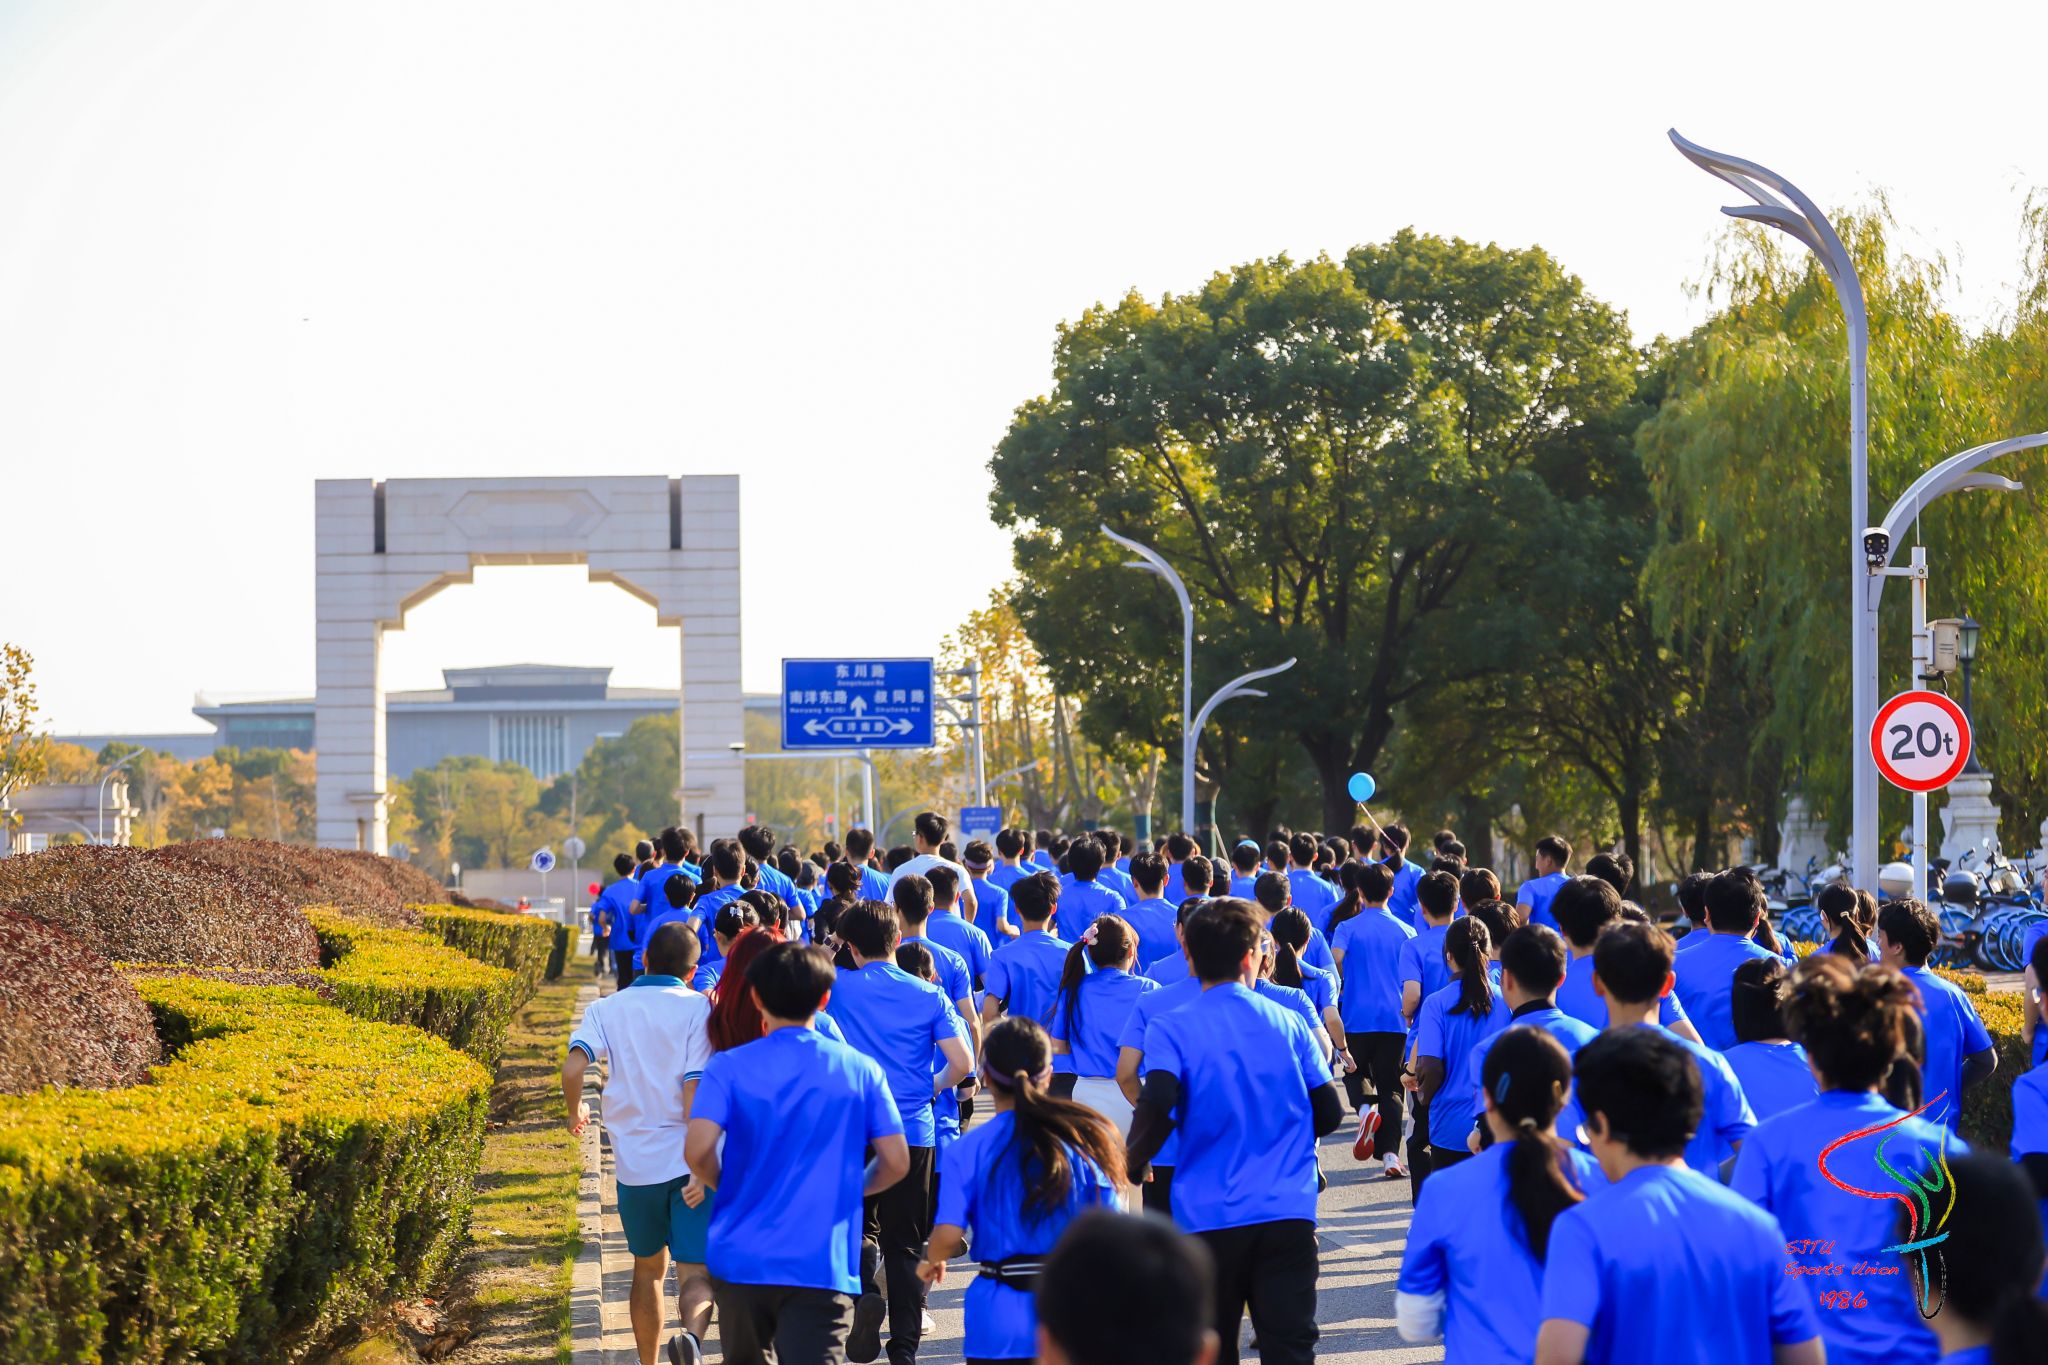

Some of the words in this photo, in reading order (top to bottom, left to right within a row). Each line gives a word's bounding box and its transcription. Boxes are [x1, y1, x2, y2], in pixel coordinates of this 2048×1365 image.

[836, 664, 885, 678] 东川路
[790, 690, 847, 704] 南洋东路
[833, 722, 884, 732] 南洋南路
[1889, 721, 1953, 760] 20t
